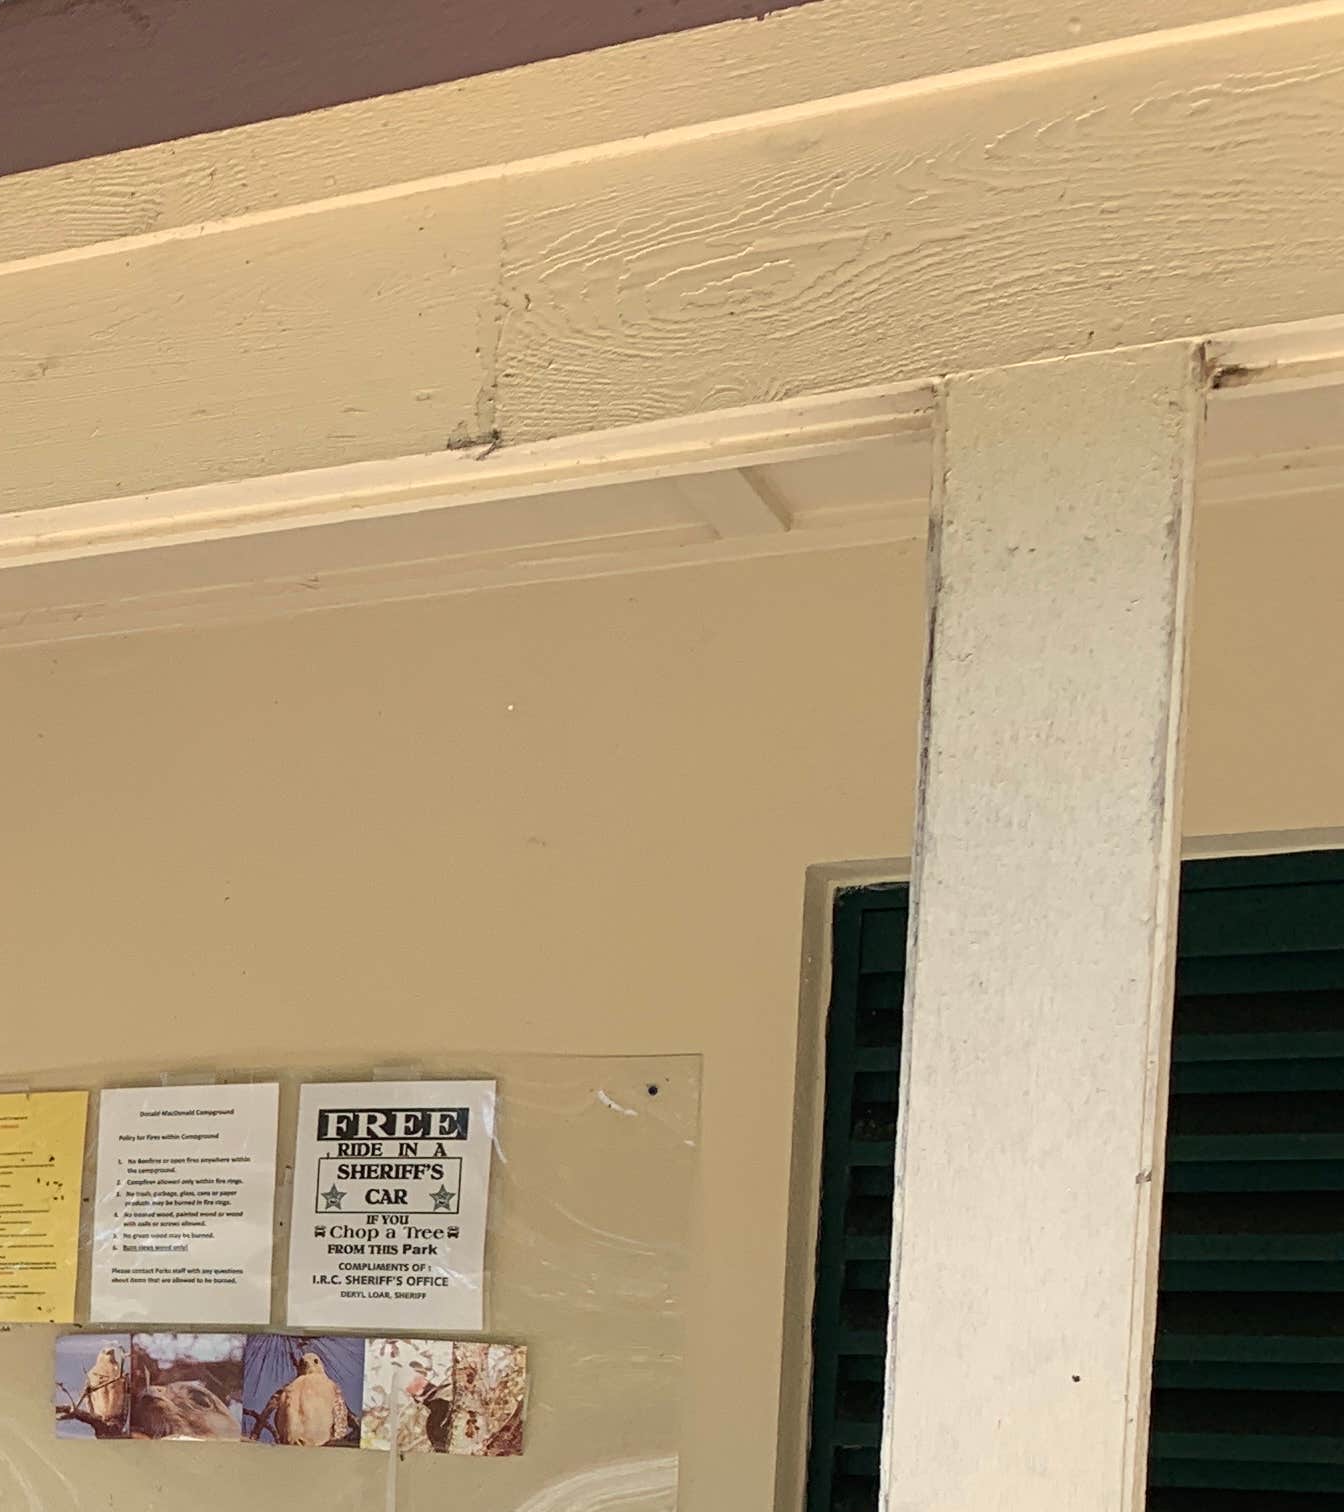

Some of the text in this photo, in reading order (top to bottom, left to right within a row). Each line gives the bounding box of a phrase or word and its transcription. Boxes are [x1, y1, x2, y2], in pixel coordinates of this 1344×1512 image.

[323, 1111, 459, 1138] FREE
[338, 1142, 447, 1157] RIDE IN A
[337, 1164, 444, 1180] SHERIFF'S
[365, 1188, 408, 1205] CAR
[366, 1215, 409, 1225] IF YOU
[330, 1225, 444, 1241] Chop a Tree
[328, 1244, 437, 1255] FROM THIS Park
[338, 1262, 409, 1271] COMPLIMENTS
[313, 1275, 448, 1287] I.R.C. SHERIFF'S OFFICE
[340, 1291, 365, 1299] DERYL
